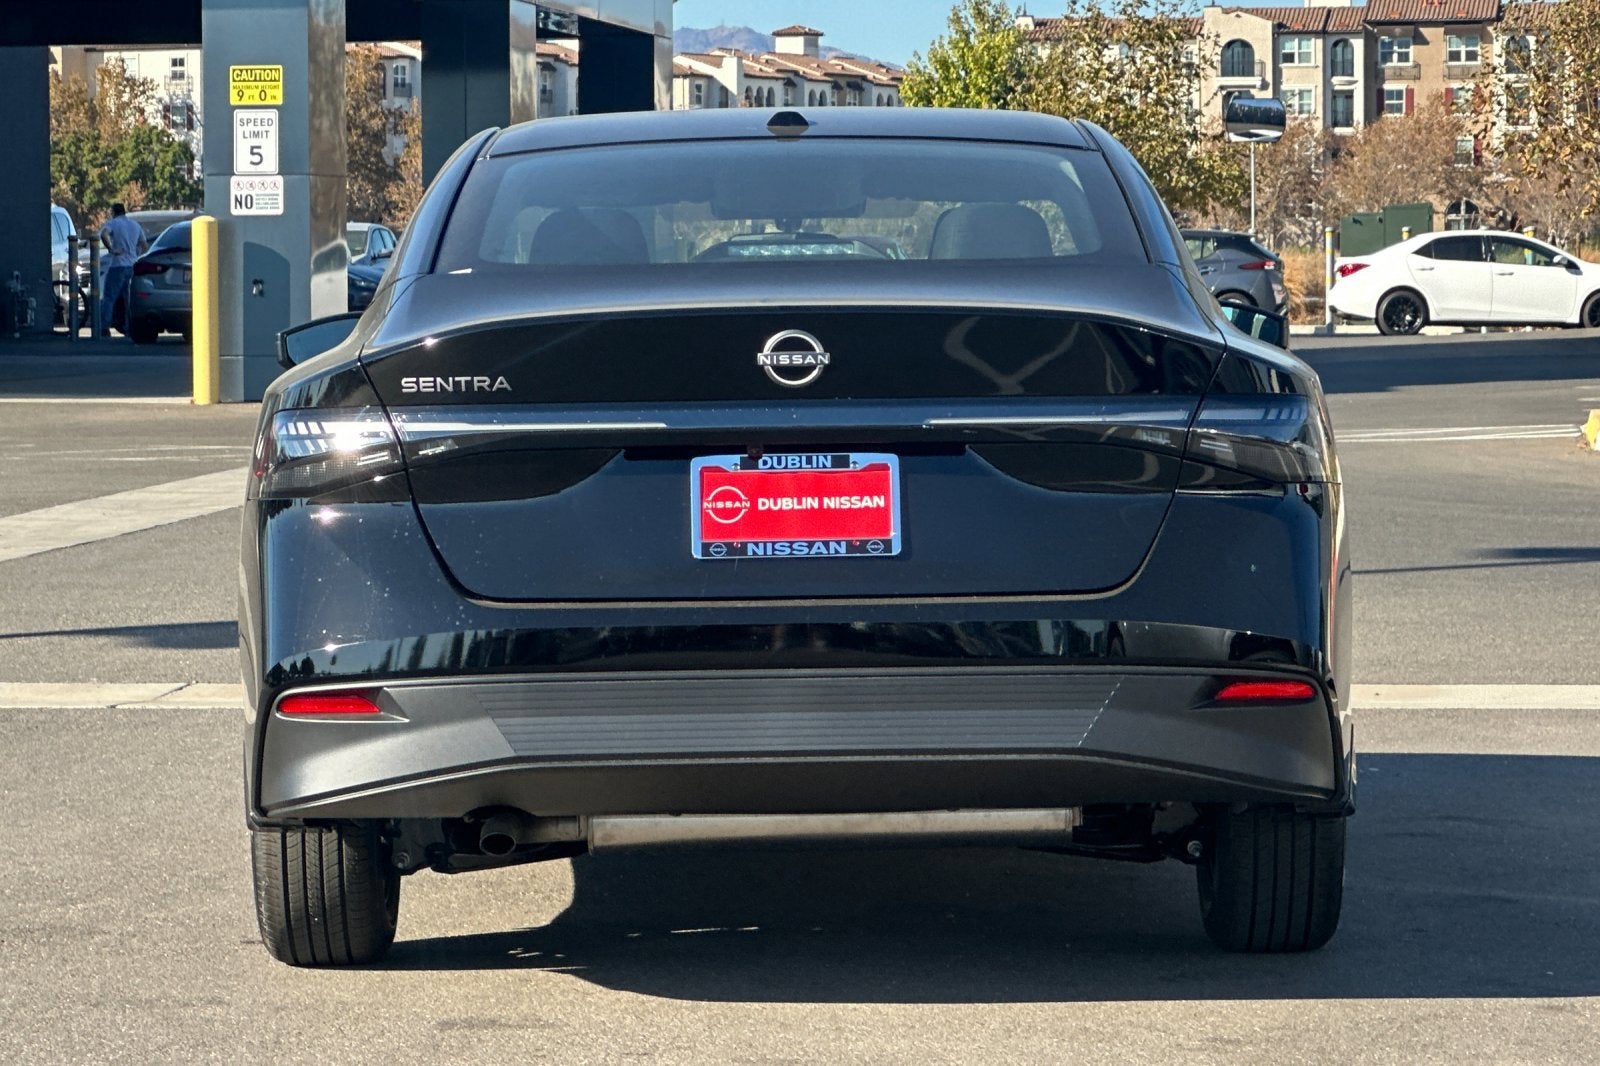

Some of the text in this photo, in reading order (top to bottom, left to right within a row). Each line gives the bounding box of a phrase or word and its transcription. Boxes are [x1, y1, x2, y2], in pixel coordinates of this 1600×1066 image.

[233, 69, 279, 81] CAUTION
[237, 89, 245, 102] 9
[259, 89, 267, 102] 0
[239, 118, 274, 127] SPEED
[242, 130, 270, 139] LIMIT
[249, 145, 264, 166] 5
[234, 193, 254, 210] NO
[760, 354, 829, 365] NISSAN
[401, 376, 512, 393] SENTRA
[758, 455, 832, 469] DUBLIN
[703, 501, 750, 509] NISSAN
[757, 495, 885, 510] DUBLIN NISSAN
[747, 541, 847, 556] NISSAN
